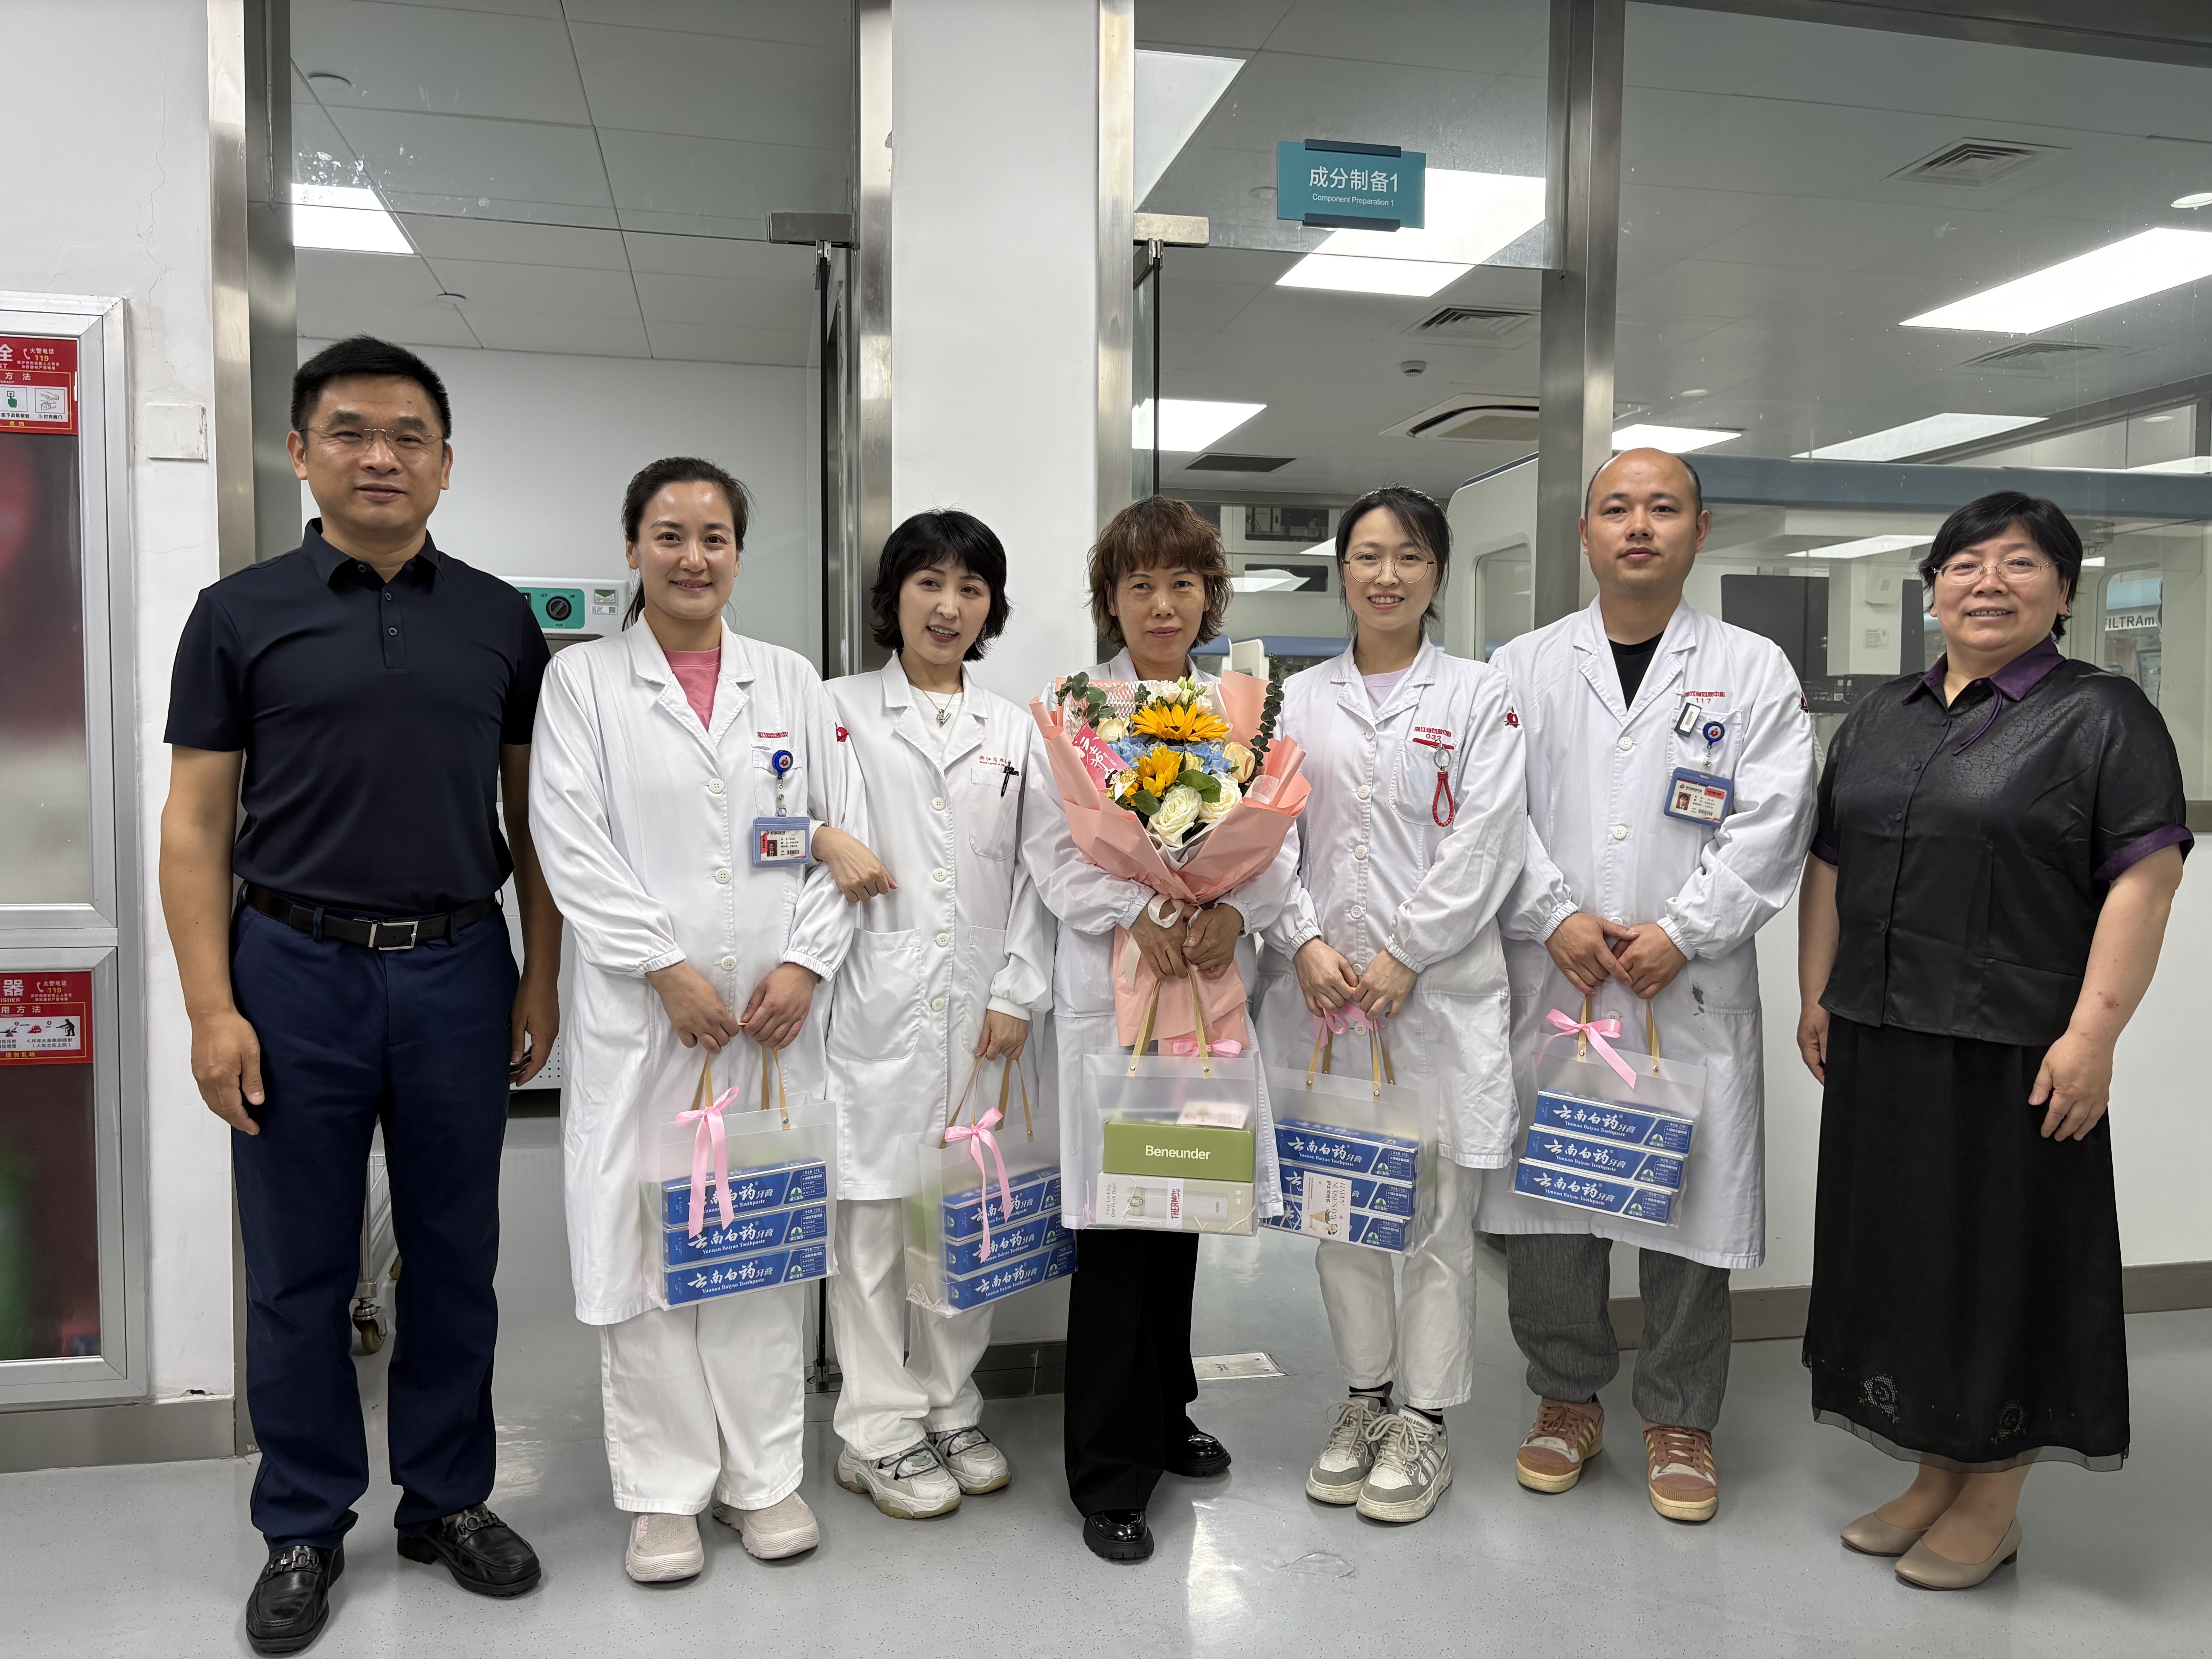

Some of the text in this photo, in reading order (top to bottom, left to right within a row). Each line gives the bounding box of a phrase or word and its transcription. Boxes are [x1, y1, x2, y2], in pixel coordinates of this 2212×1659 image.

[1309, 166, 1398, 192] 成分制备1
[1312, 194, 1350, 203] Component
[1352, 197, 1389, 206] Preparation
[3, 979, 24, 996] 器
[1553, 1104, 1619, 1129] 云南白药
[1600, 1127, 1625, 1137] Toothpaste
[1145, 1145, 1211, 1159] Beneunder
[1288, 1136, 1347, 1160] 云南白药
[1544, 1139, 1609, 1164] 云南白药
[1331, 1158, 1354, 1166] Toothpaste
[1591, 1162, 1616, 1172] Toothpaste
[1533, 1172, 1598, 1197] 云南白药
[739, 1199, 765, 1208] Toothpaste
[1170, 1188, 1180, 1219] THERMOS
[1580, 1195, 1605, 1206] Toothpaste
[1011, 1208, 1027, 1217] oothpaste
[688, 1223, 755, 1250] 云南白药
[739, 1238, 765, 1248] Toothpaste
[687, 1262, 754, 1289] 云南白药
[739, 1278, 764, 1286] Toothpaste
[975, 1265, 1025, 1293] 云南白药
[1012, 1278, 1031, 1288] Toothpaste
